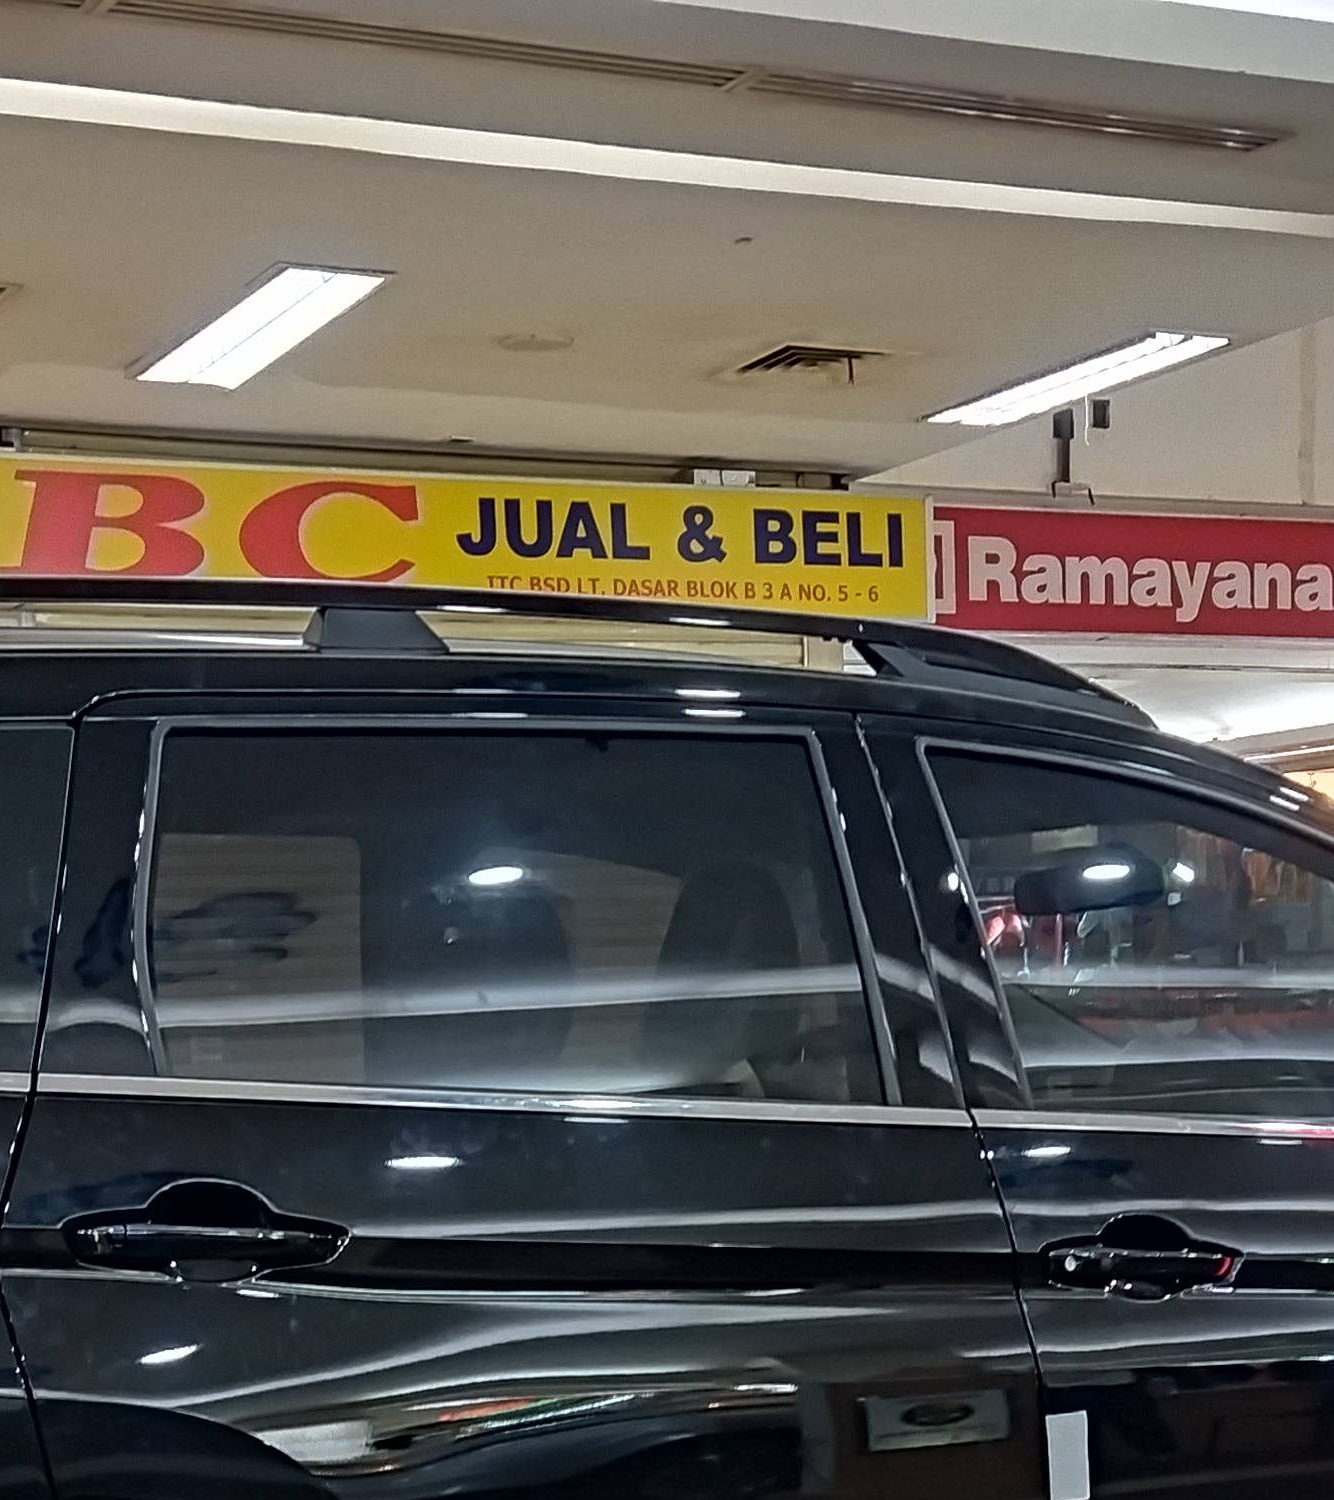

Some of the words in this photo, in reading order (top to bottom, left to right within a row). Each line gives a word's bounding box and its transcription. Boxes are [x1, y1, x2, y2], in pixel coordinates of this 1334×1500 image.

[456, 497, 651, 561] JUAL
[676, 505, 727, 563] &
[752, 508, 905, 568] BELI
[529, 576, 570, 593] BSD
[577, 577, 605, 595] LT.
[613, 578, 680, 597] DASAR
[686, 580, 738, 599] BLOK
[744, 581, 756, 600] B
[762, 582, 774, 600] 3
[779, 583, 792, 601] A
[798, 583, 832, 602] NO.
[838, 585, 848, 602] 5
[868, 585, 879, 602] 6
[968, 535, 1334, 623] Ramayana
